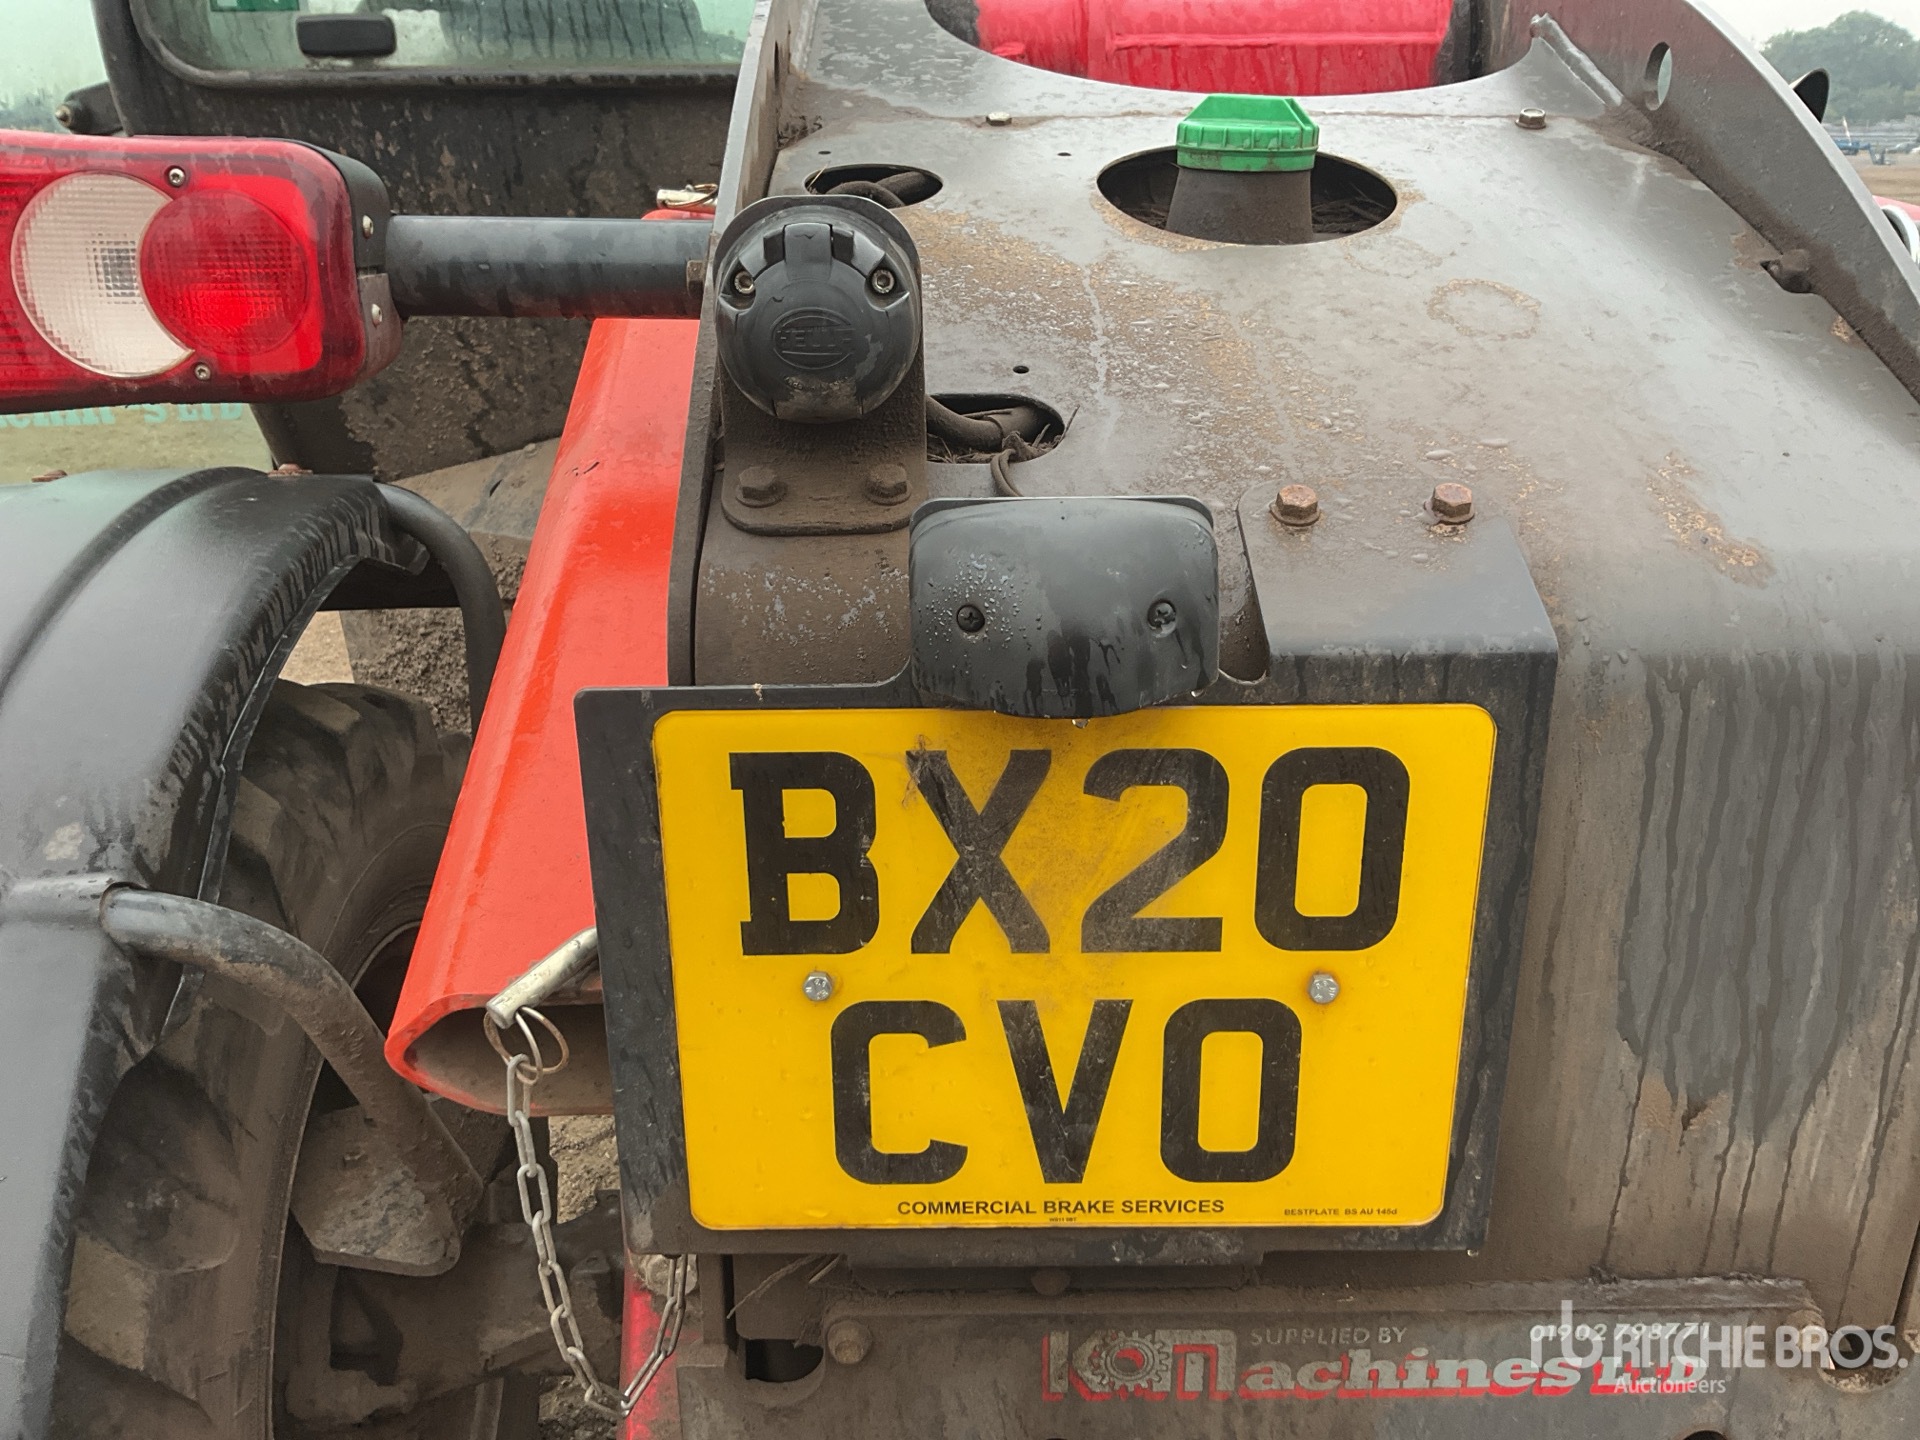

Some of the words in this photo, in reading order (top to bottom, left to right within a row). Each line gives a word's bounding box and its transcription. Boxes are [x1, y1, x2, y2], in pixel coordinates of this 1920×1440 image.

[729, 745, 1411, 955] BX20
[830, 997, 1303, 1185] CVO
[897, 1200, 1037, 1215] COMMERCIAL
[1043, 1200, 1115, 1215] BRAKE
[1121, 1199, 1225, 1214] SERVICES
[1284, 1208, 1340, 1216] BESTPLATE
[1344, 1208, 1358, 1216] BS
[1360, 1208, 1374, 1216] AU
[1250, 1326, 1371, 1346] SUPPLIED
[1377, 1326, 1408, 1345] BY
